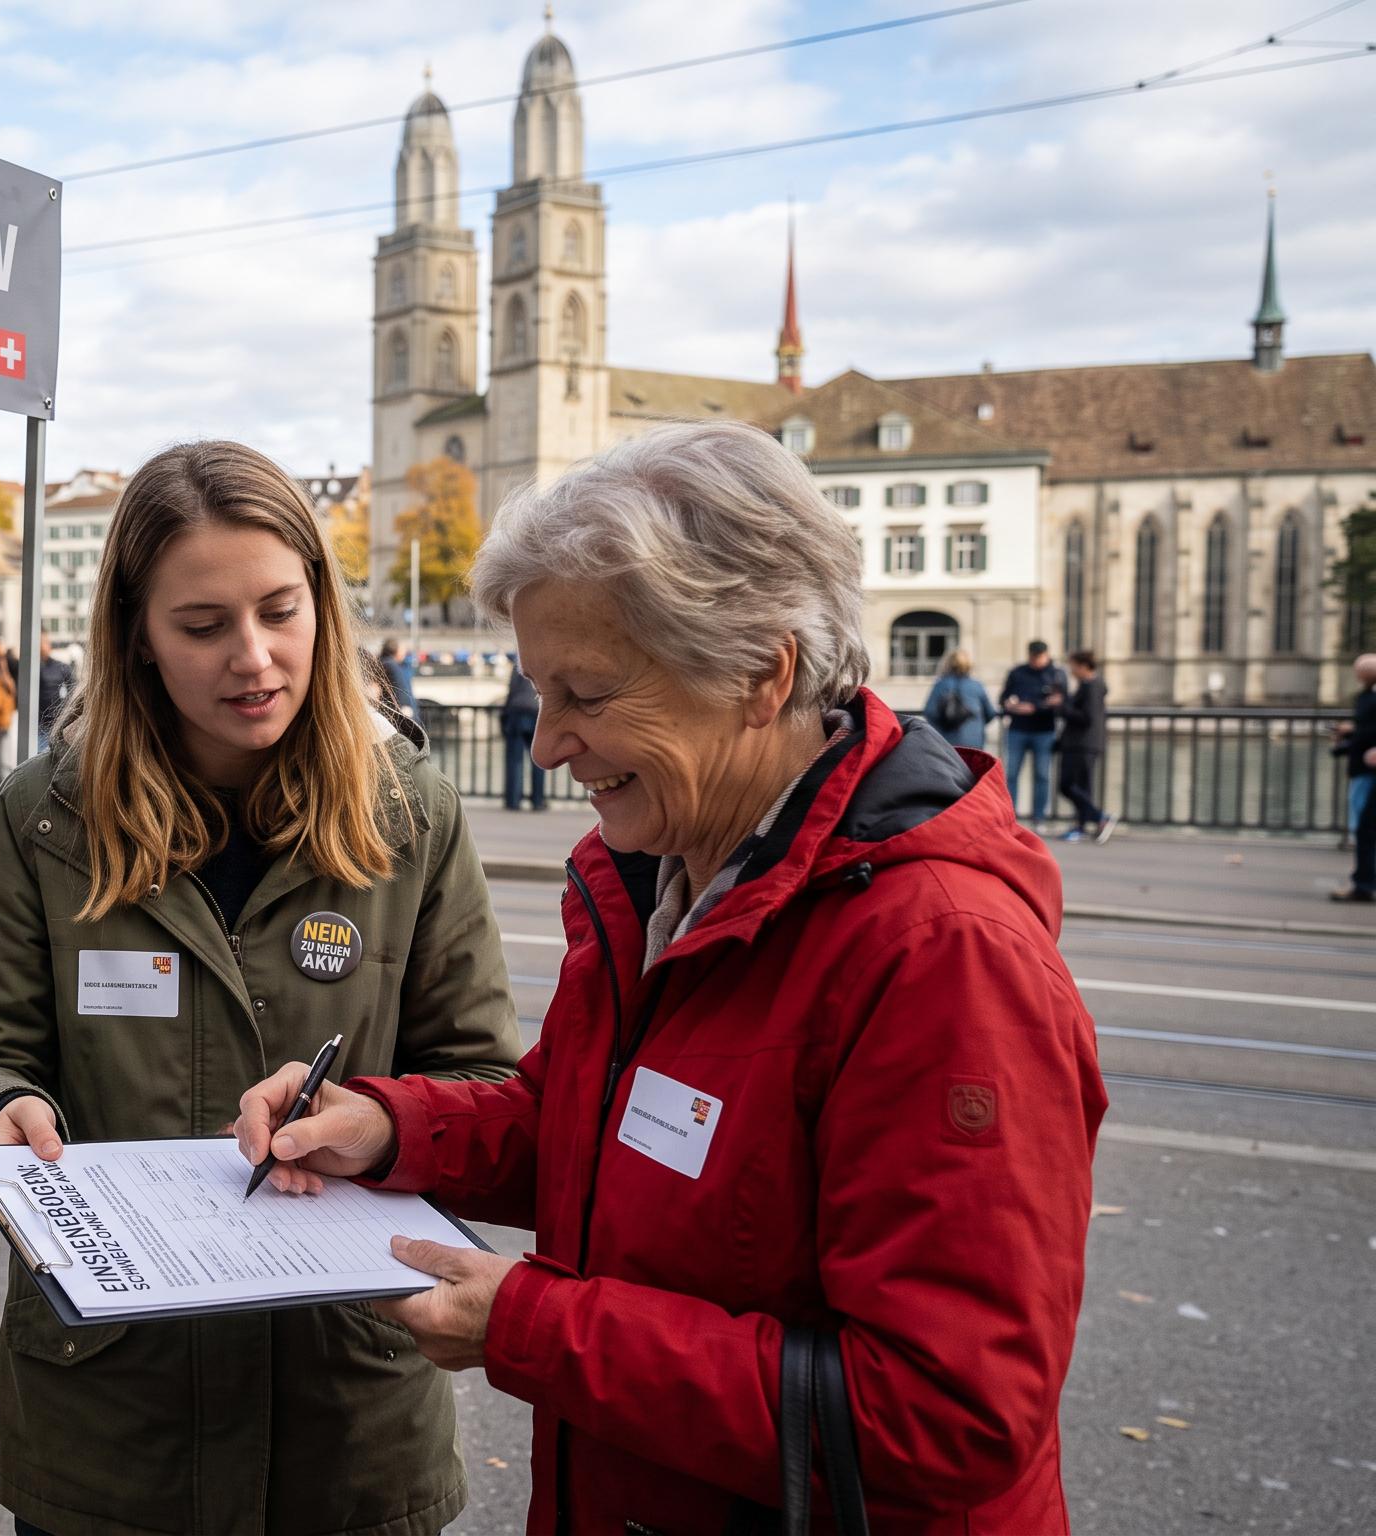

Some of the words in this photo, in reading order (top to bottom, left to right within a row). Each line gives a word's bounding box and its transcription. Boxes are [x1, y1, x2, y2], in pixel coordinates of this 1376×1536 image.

[303, 920, 352, 945] NEIN
[300, 940, 315, 952] ZU
[316, 943, 351, 958] NEUEN
[301, 953, 345, 973] AKW
[79, 1211, 112, 1239] OHNE
